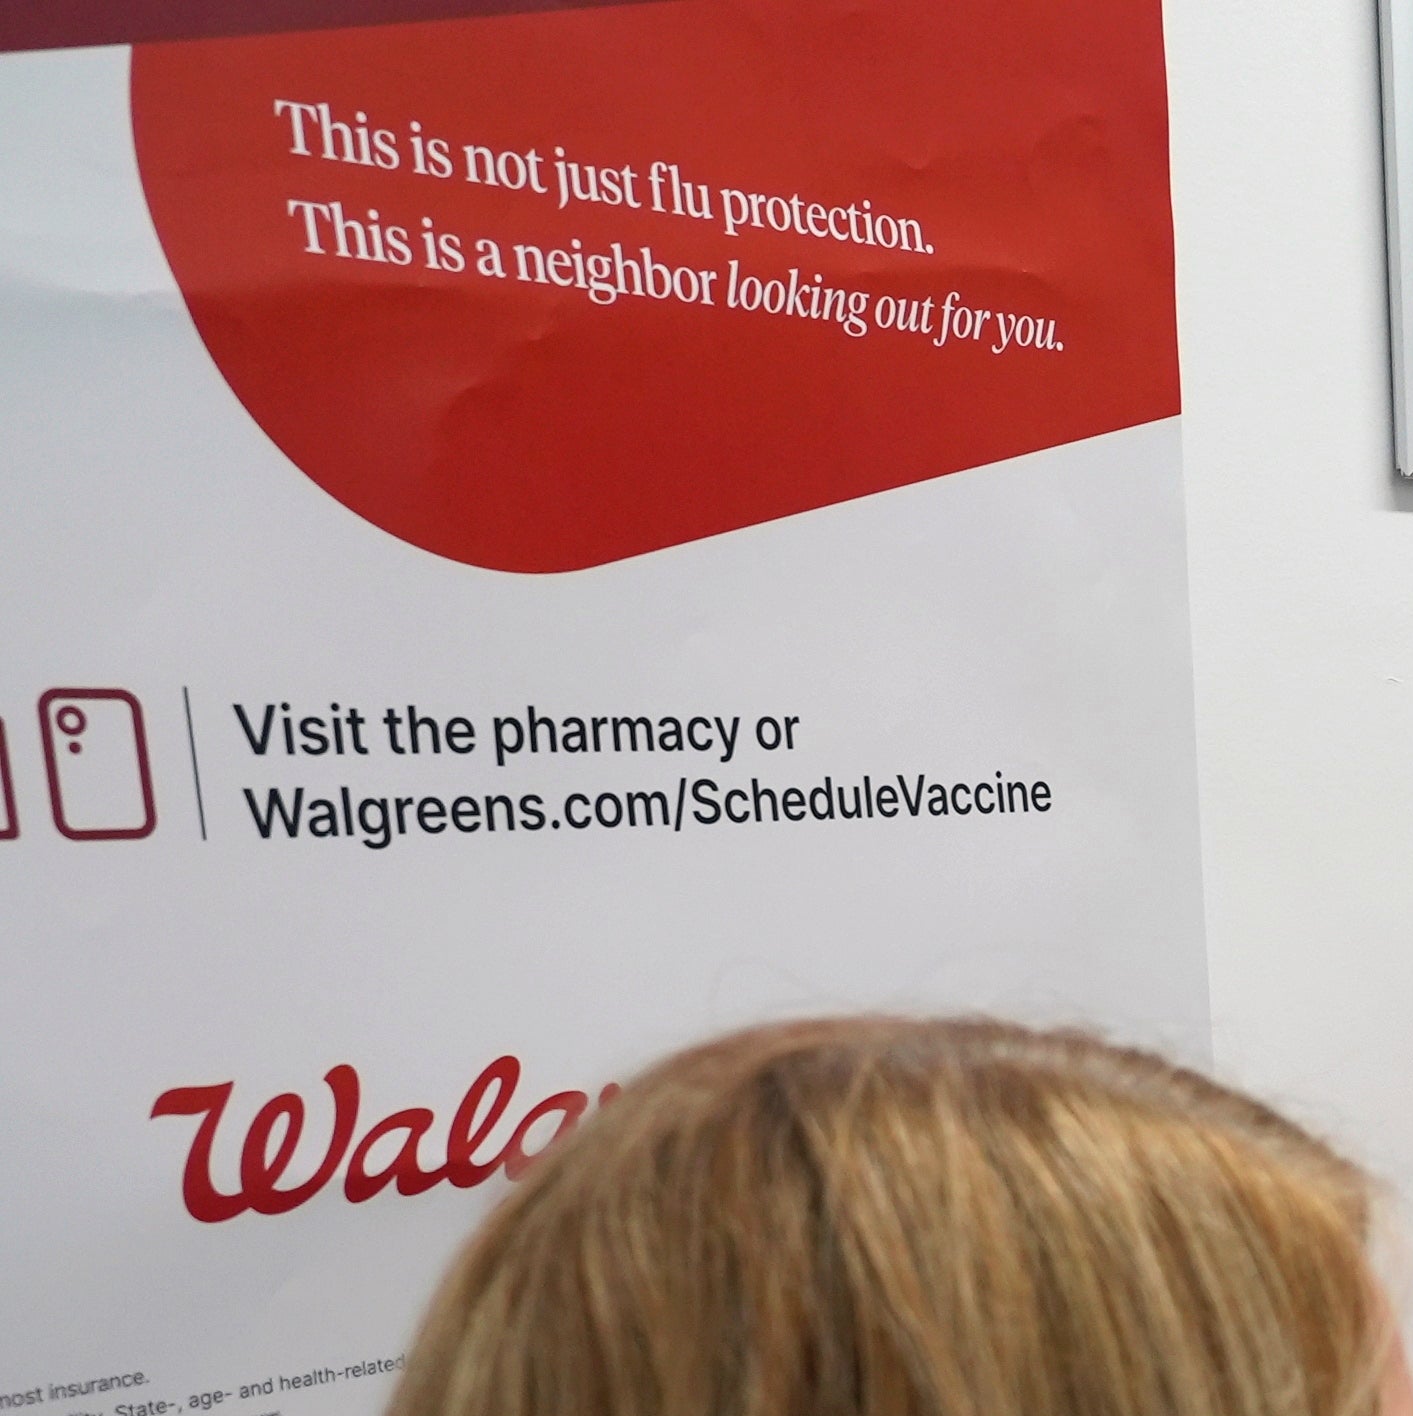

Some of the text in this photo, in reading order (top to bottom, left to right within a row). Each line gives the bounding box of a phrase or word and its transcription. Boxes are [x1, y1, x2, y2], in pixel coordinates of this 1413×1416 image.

[274, 99, 935, 255] This is not just flu protection.
[287, 199, 1064, 354] This is a neighbor looking out for you.
[232, 702, 800, 767] Visit the pharmacy or
[243, 770, 1052, 850] Walgreens.com/ScheduleVaccine
[49, 1371, 150, 1400] insurance.
[188, 1389, 233, 1410] age-
[239, 1378, 274, 1398] and
[279, 1353, 406, 1393] health-related
